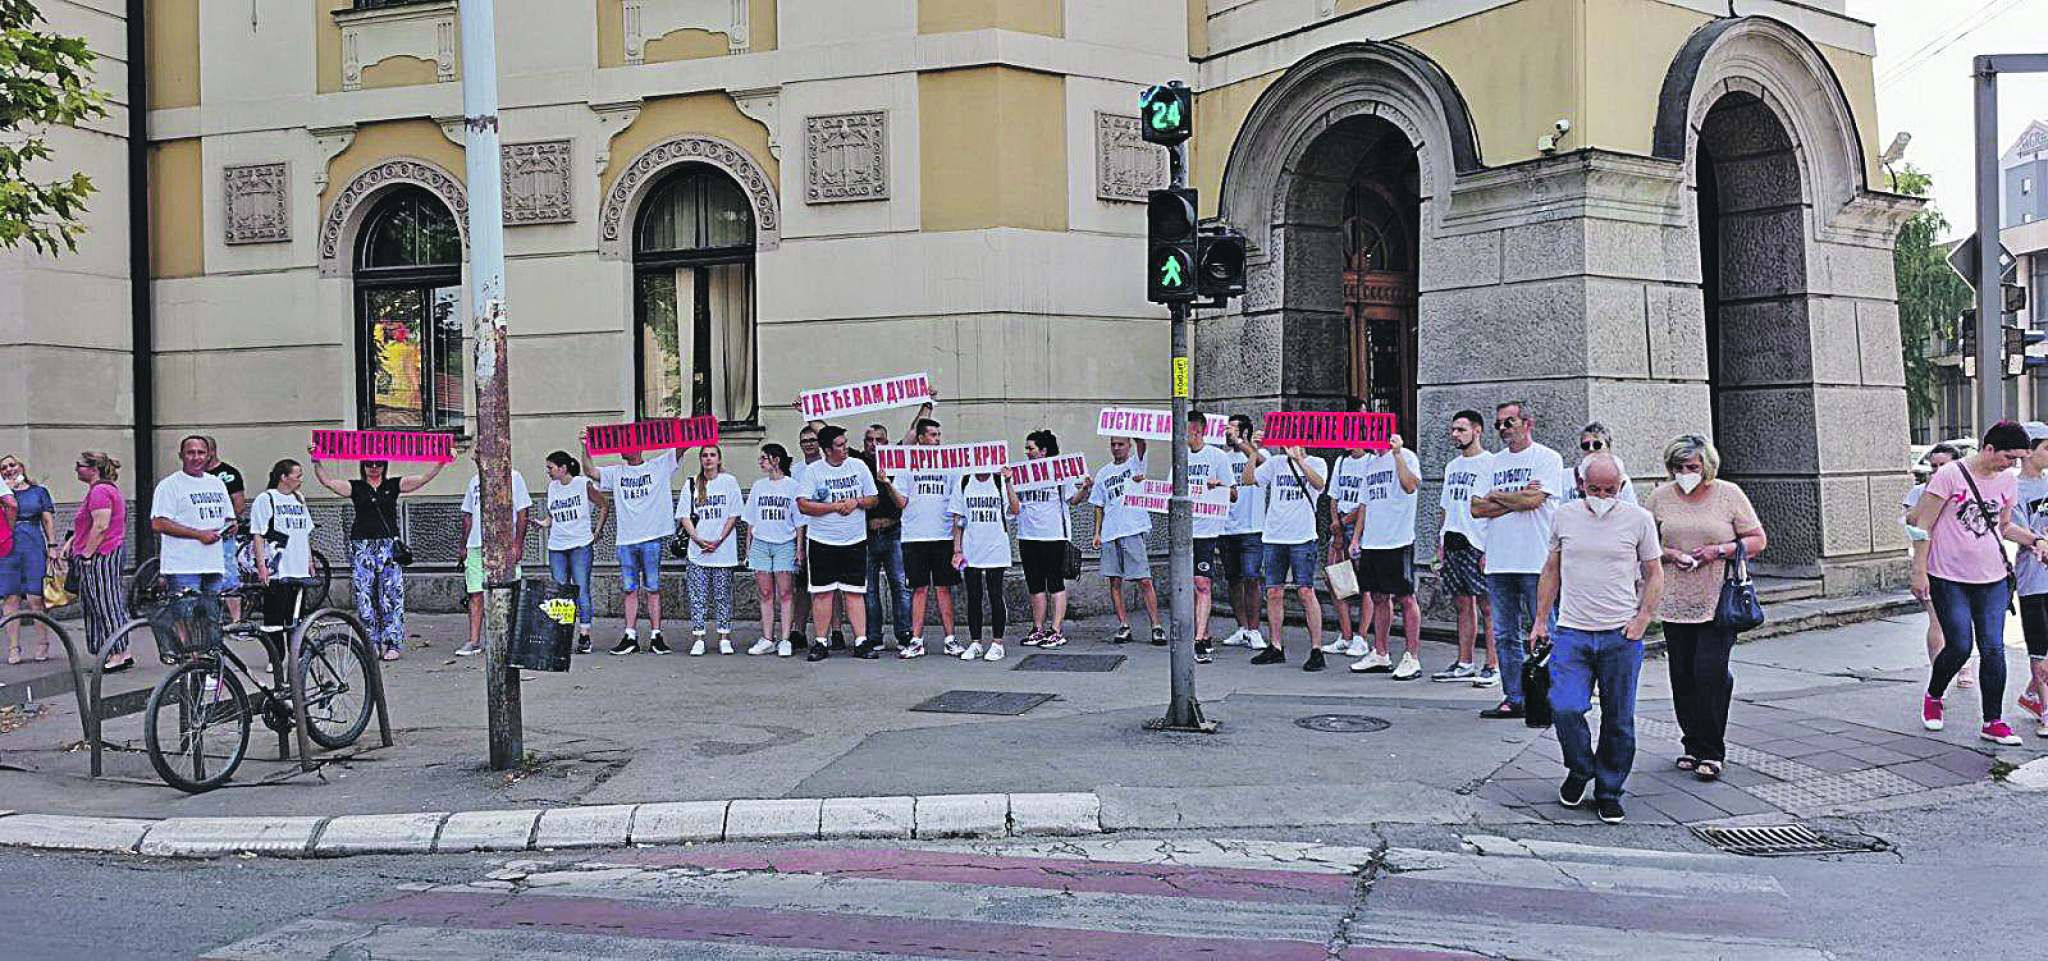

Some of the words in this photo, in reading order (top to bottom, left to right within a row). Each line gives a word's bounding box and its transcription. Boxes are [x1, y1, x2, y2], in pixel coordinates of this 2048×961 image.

[1152, 101, 1180, 128] 24
[803, 392, 831, 416] ГДЕ
[853, 383, 884, 406] ВАМ
[886, 377, 930, 404] ДУША
[1101, 411, 1152, 432] ПУСТИТЕ
[1264, 415, 1337, 443] ОСЛОБОДИТЕ
[1343, 416, 1393, 443] ОГЊЕНА
[361, 433, 396, 456] ПОСАО
[400, 434, 452, 456] ПОШТЕНО
[878, 449, 906, 469] НАШ
[910, 449, 939, 471] ДРУГ
[940, 447, 970, 468] НИЈЕ
[973, 445, 1007, 466] КРИВ
[1031, 461, 1049, 482] ВИ
[1053, 456, 1085, 481] ДЕЦУ
